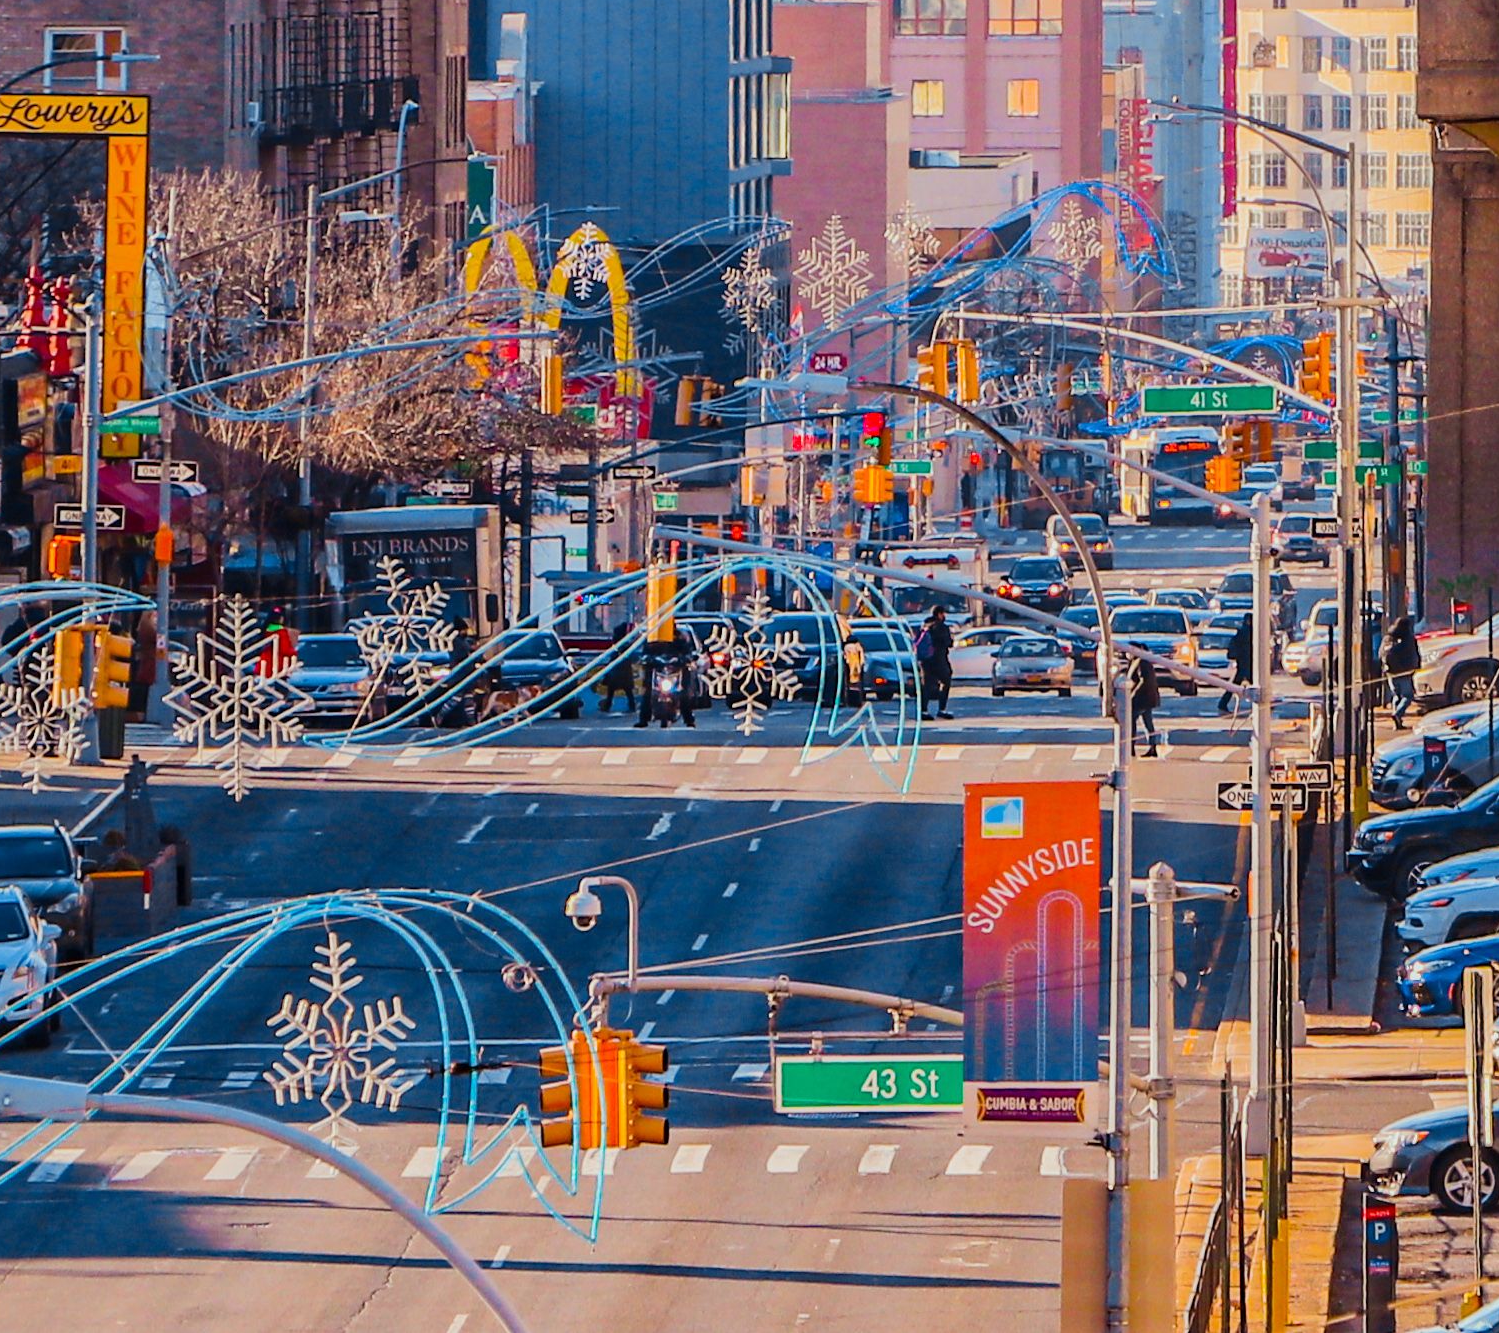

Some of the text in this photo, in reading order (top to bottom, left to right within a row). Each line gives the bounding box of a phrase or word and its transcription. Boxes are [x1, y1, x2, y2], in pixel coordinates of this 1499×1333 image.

[111, 143, 143, 247] WINE
[110, 271, 136, 454] FACTOY
[1189, 390, 1229, 409] 41 St
[389, 536, 470, 554] BRANDS
[1298, 769, 1324, 781] WAY
[1226, 791, 1252, 802] ONE
[966, 837, 1095, 935] SUNNYSIDE
[860, 1068, 941, 1099] 43 St
[985, 1096, 1077, 1112] CUMBIA & SABOR
[1374, 1222, 1387, 1241] P
